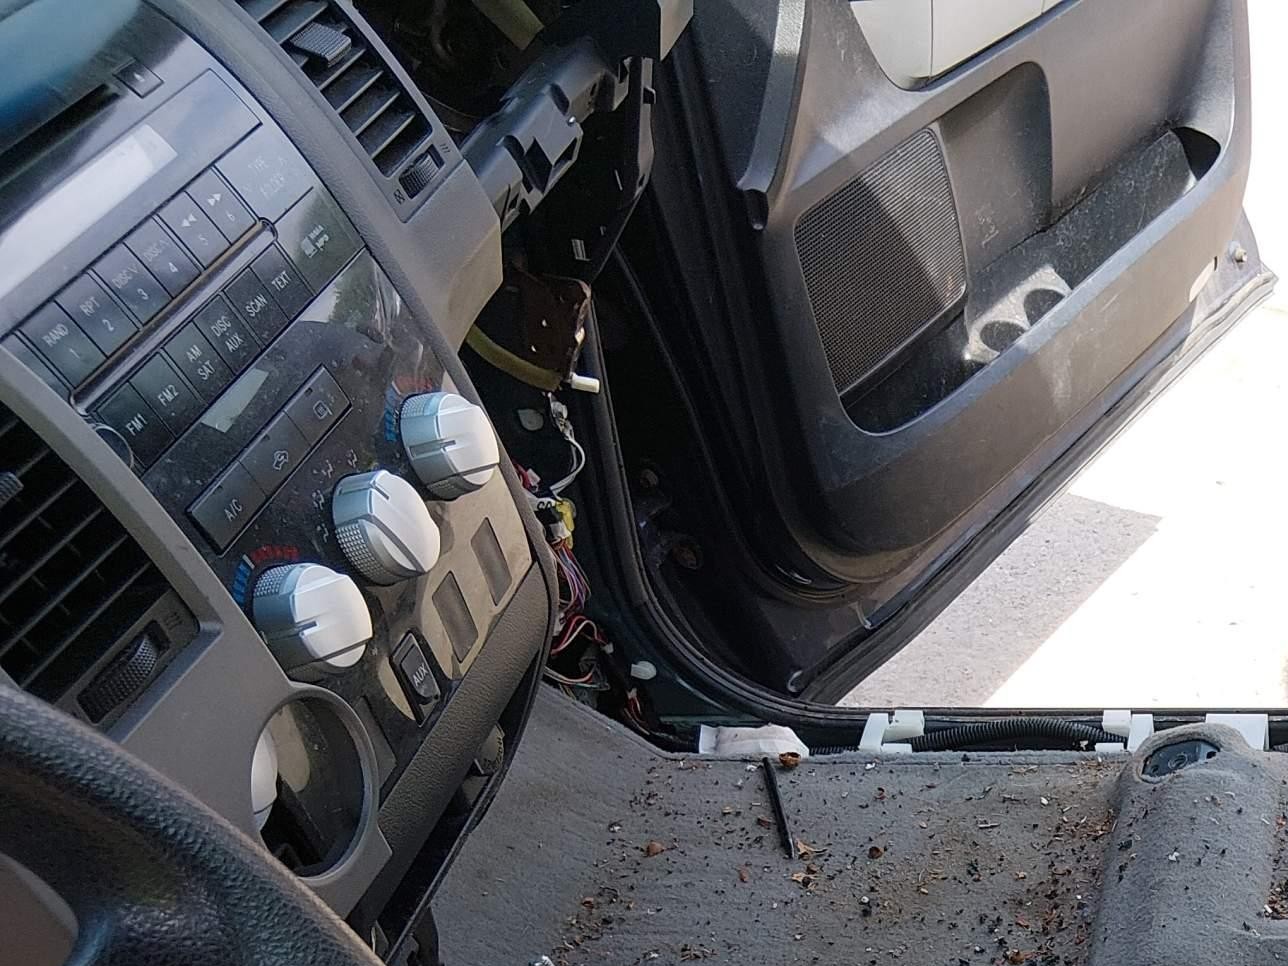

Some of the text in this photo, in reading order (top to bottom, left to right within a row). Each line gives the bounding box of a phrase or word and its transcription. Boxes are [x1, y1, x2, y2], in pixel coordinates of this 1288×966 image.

[168, 262, 178, 272] 4
[271, 270, 292, 292] TEXT
[137, 288, 149, 300] 3
[244, 293, 268, 317] SCAN
[79, 296, 100, 317] RPT
[42, 323, 69, 347] RAND
[102, 319, 115, 332] 2
[210, 315, 232, 337] DISC
[186, 344, 203, 363] AM
[225, 333, 244, 352] AUX
[197, 360, 216, 381] SAT
[157, 384, 179, 407] FM2
[125, 412, 148, 437] FM1
[224, 498, 242, 521] A/C
[412, 662, 429, 687] AUX
